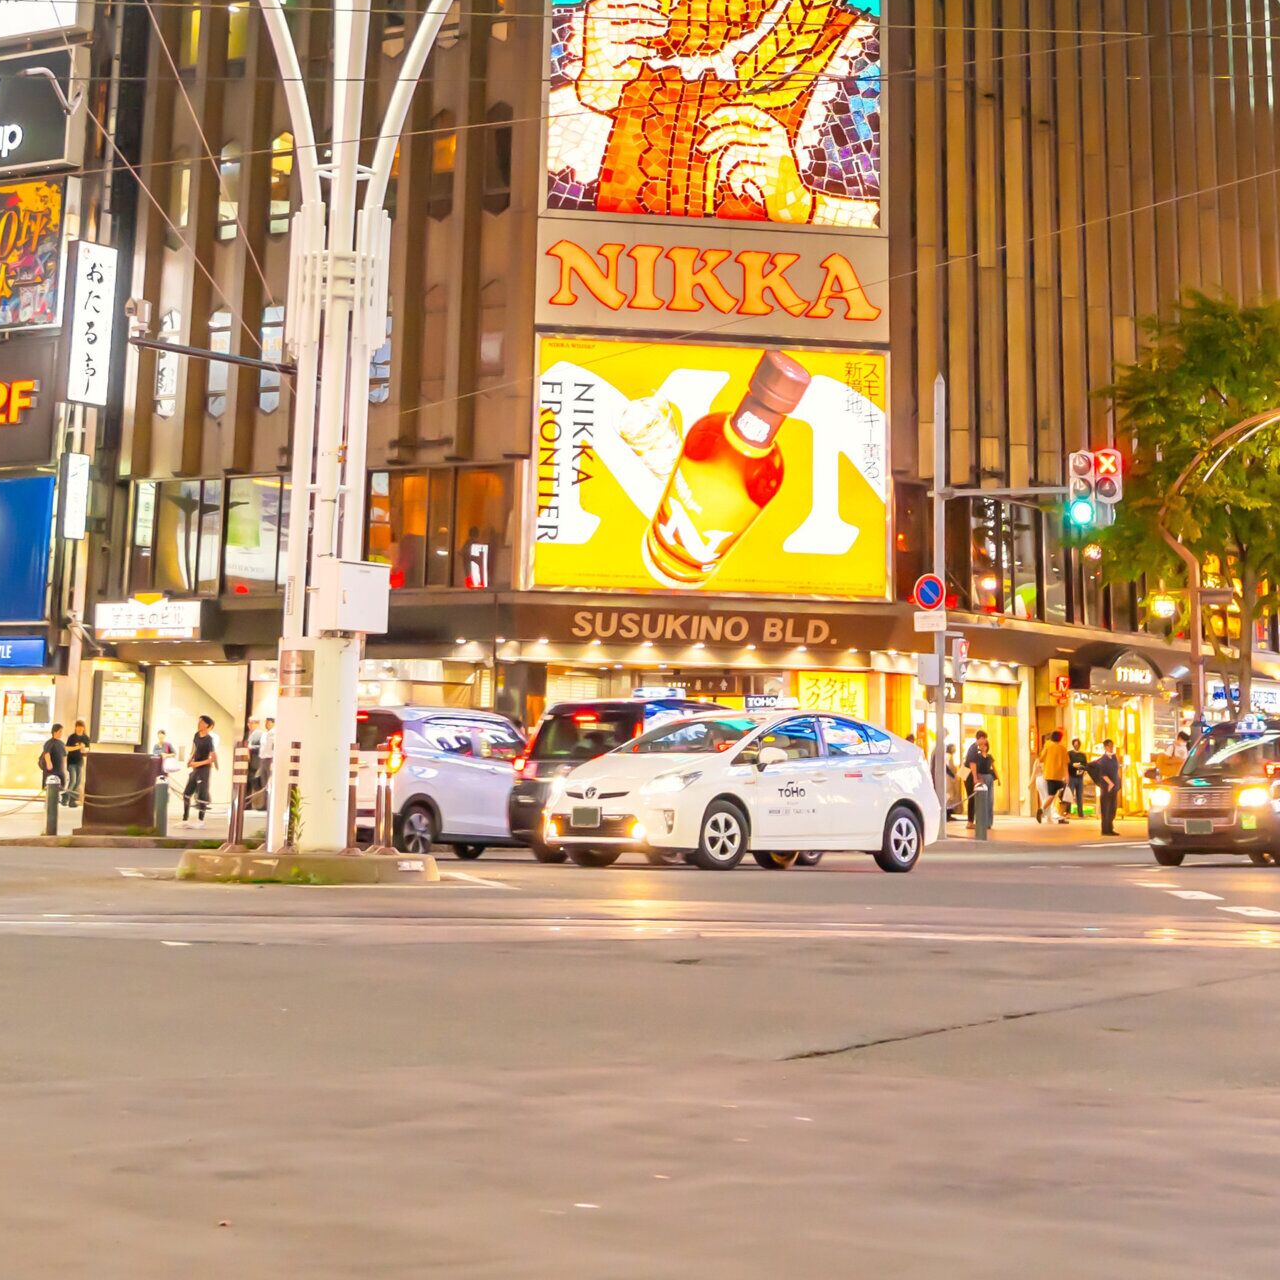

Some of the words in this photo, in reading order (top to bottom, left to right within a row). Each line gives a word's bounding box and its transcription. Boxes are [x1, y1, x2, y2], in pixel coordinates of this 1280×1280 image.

[545, 238, 882, 323] NIKKA
[536, 380, 562, 542] FRONTIER
[571, 382, 595, 486] NIKKA
[572, 610, 749, 641] SUSUKINO
[763, 618, 837, 645] BLD.
[747, 696, 776, 708] TOHO
